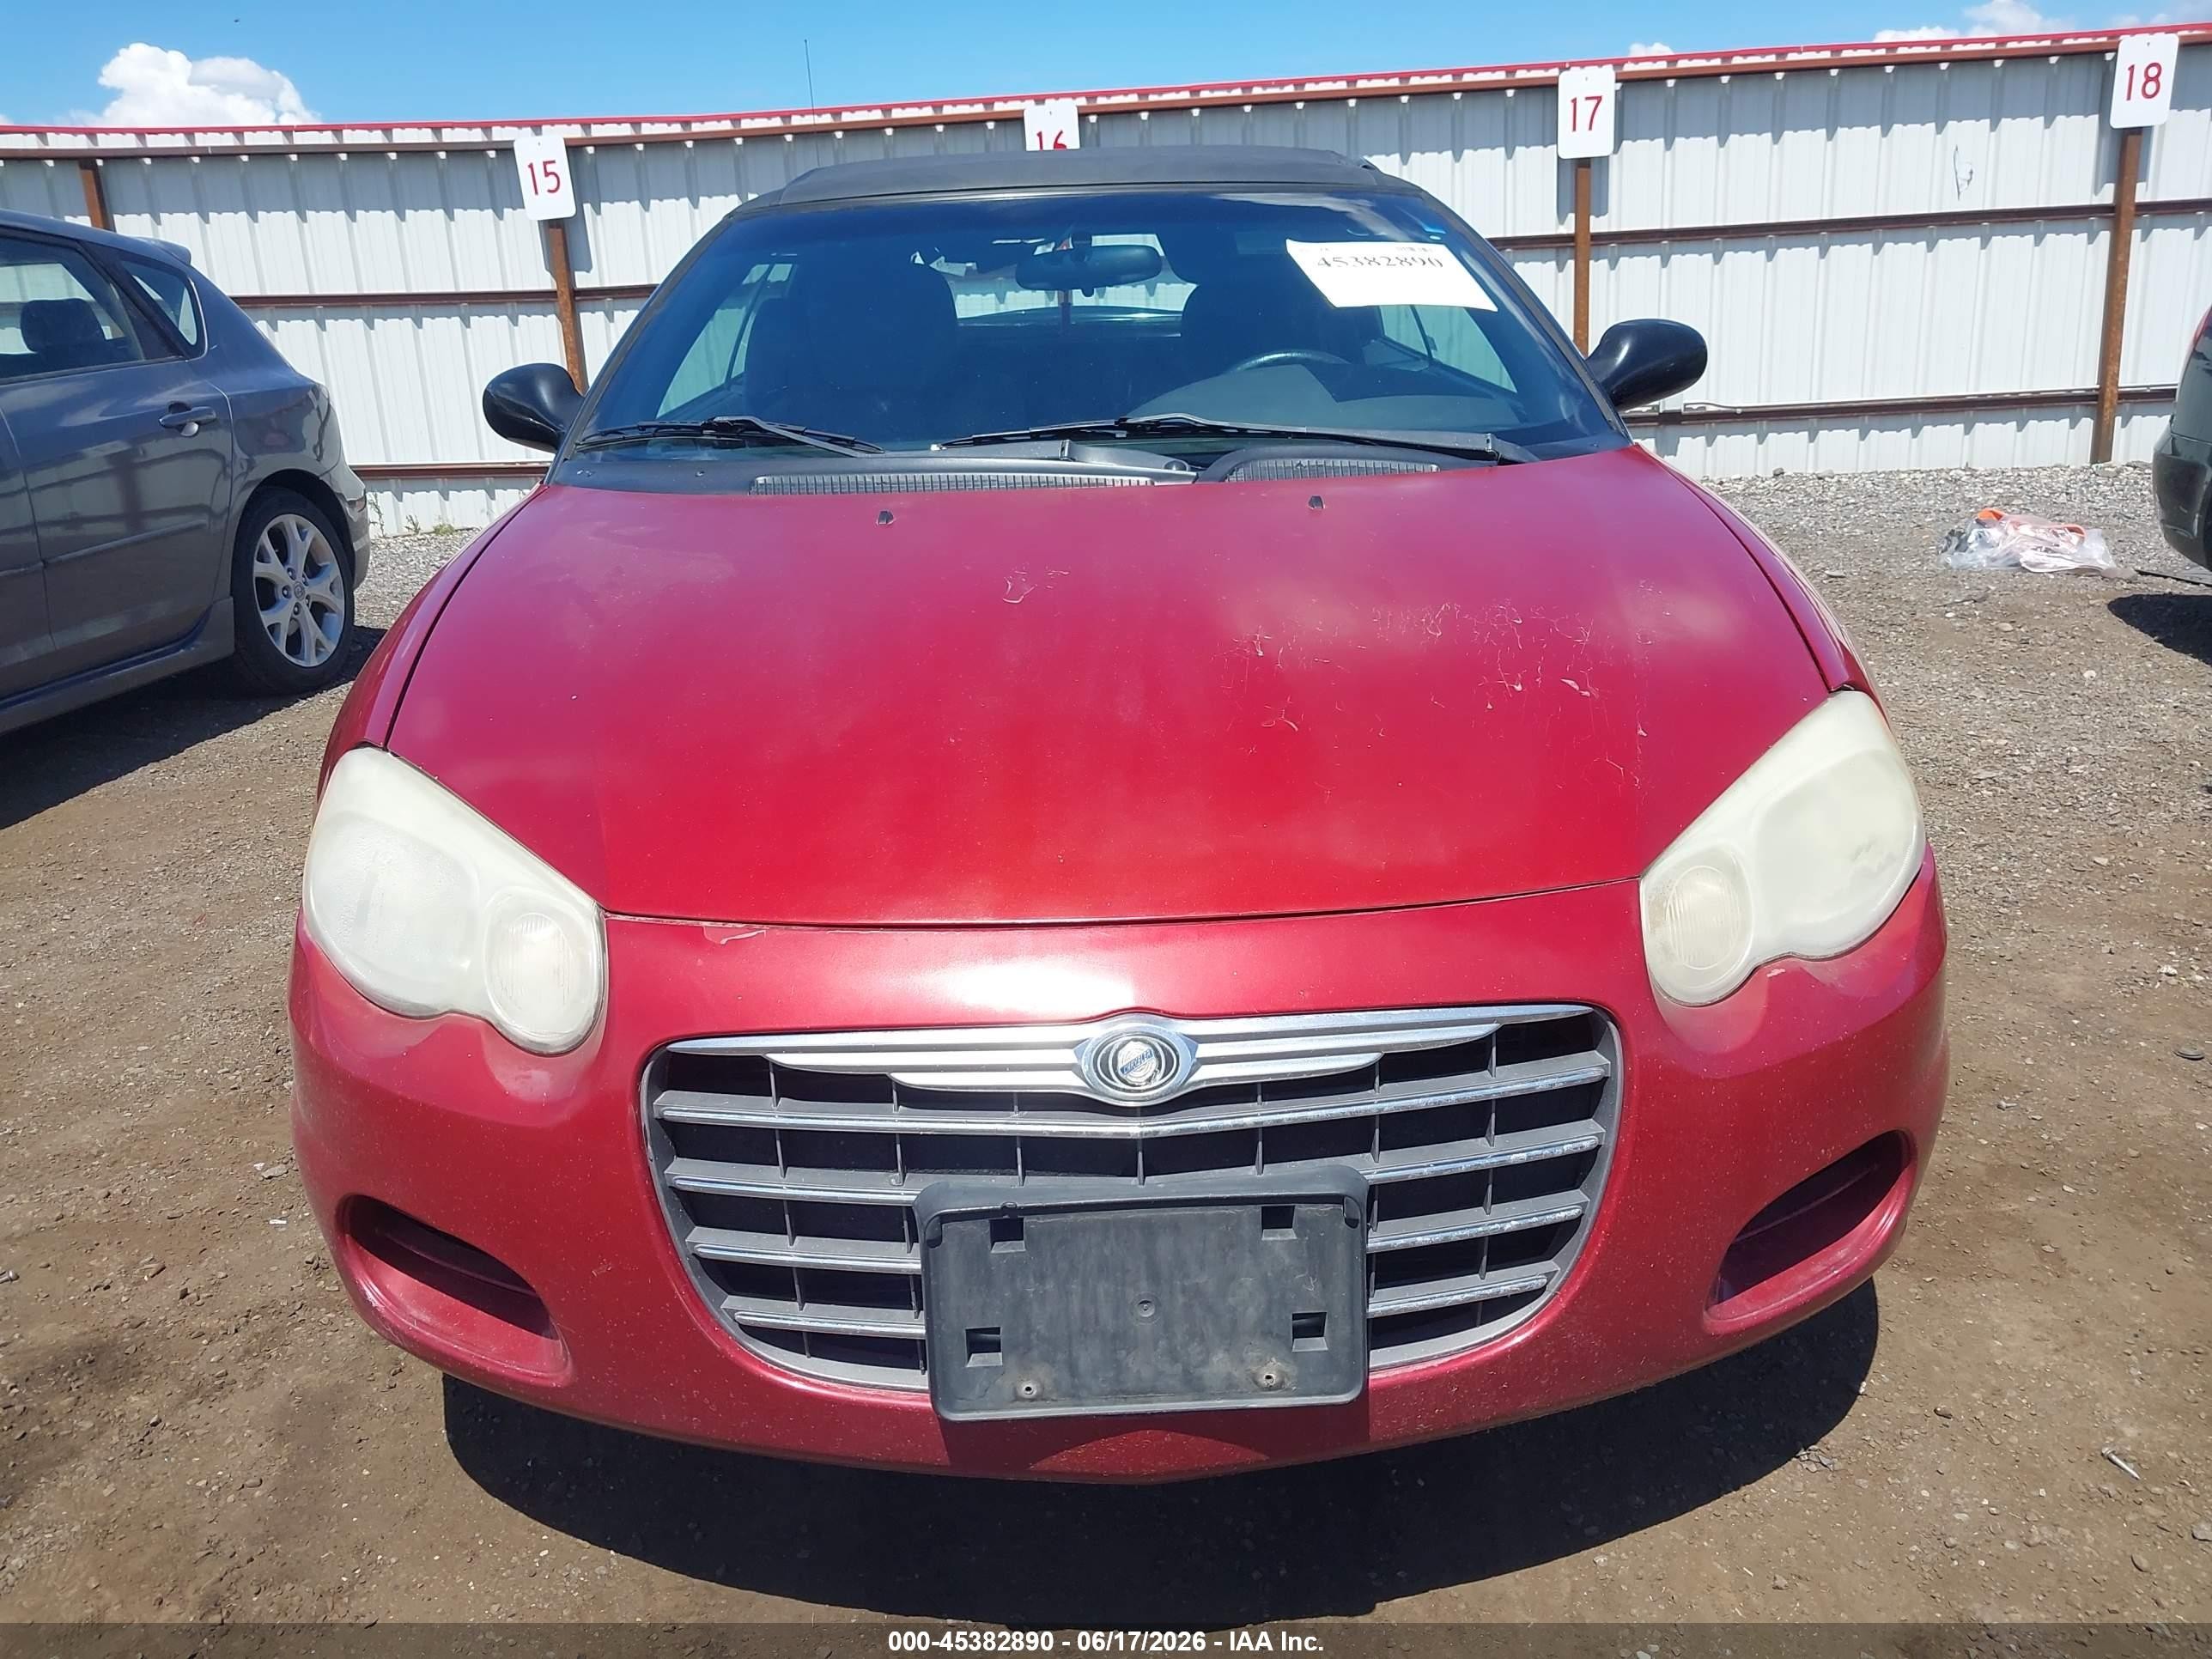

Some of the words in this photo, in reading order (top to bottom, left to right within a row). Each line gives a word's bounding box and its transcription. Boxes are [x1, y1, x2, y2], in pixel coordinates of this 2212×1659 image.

[2126, 63, 2162, 101] 18
[1571, 95, 1602, 132] 17
[528, 161, 561, 196] 15
